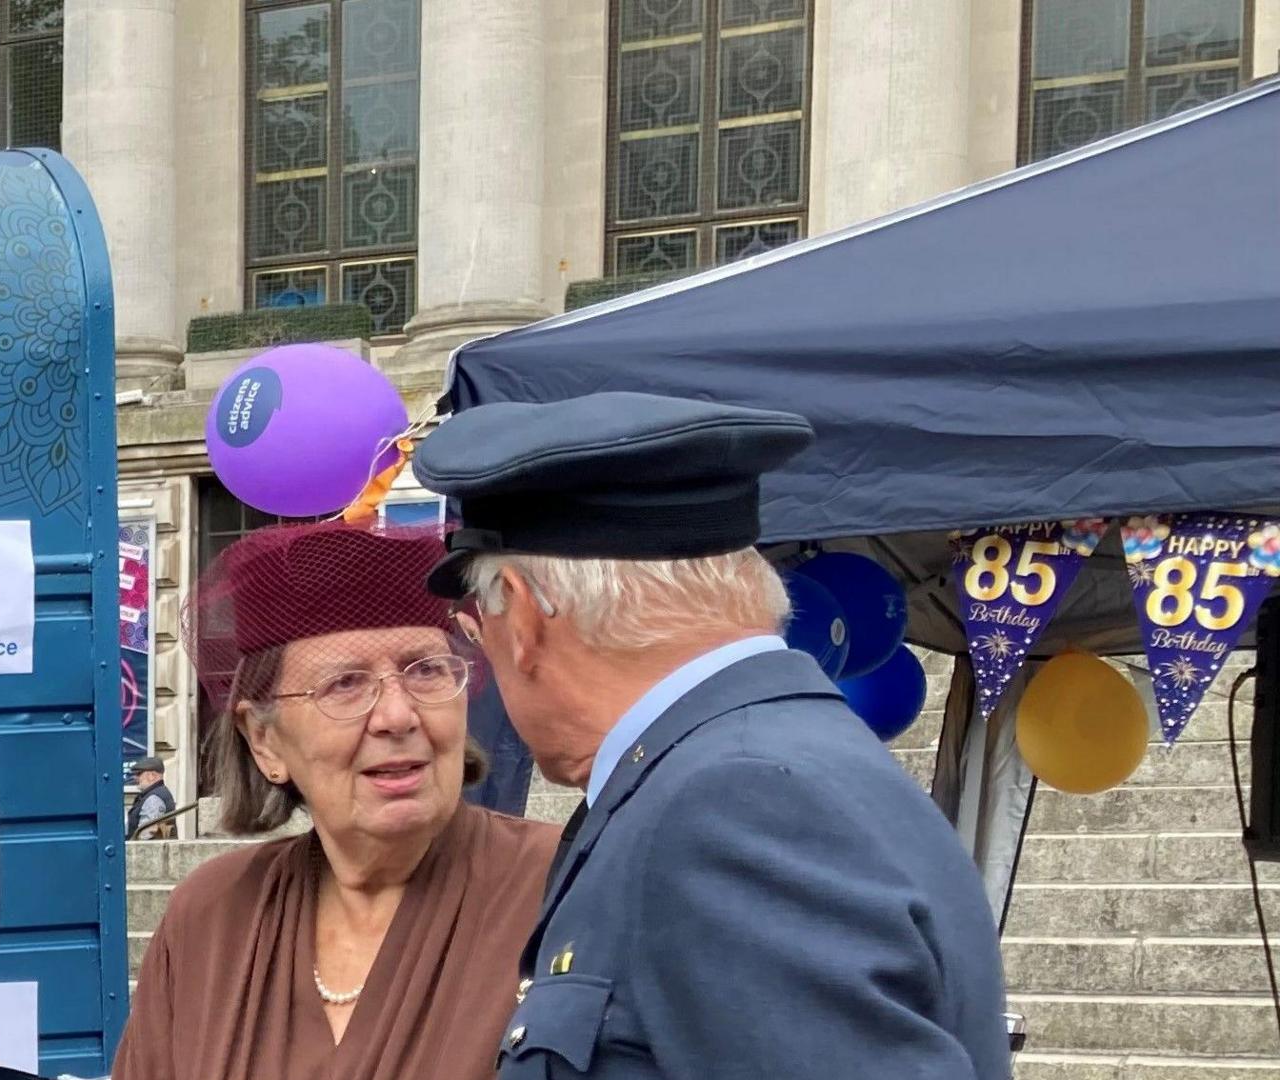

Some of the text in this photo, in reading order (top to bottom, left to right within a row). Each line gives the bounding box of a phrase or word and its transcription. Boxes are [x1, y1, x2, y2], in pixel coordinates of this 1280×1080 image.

[228, 378, 251, 434] citizens
[241, 382, 261, 430] advice
[1168, 535, 1246, 559] HAPPY
[968, 602, 1040, 634] Birthday
[1150, 628, 1228, 660] Birthday
